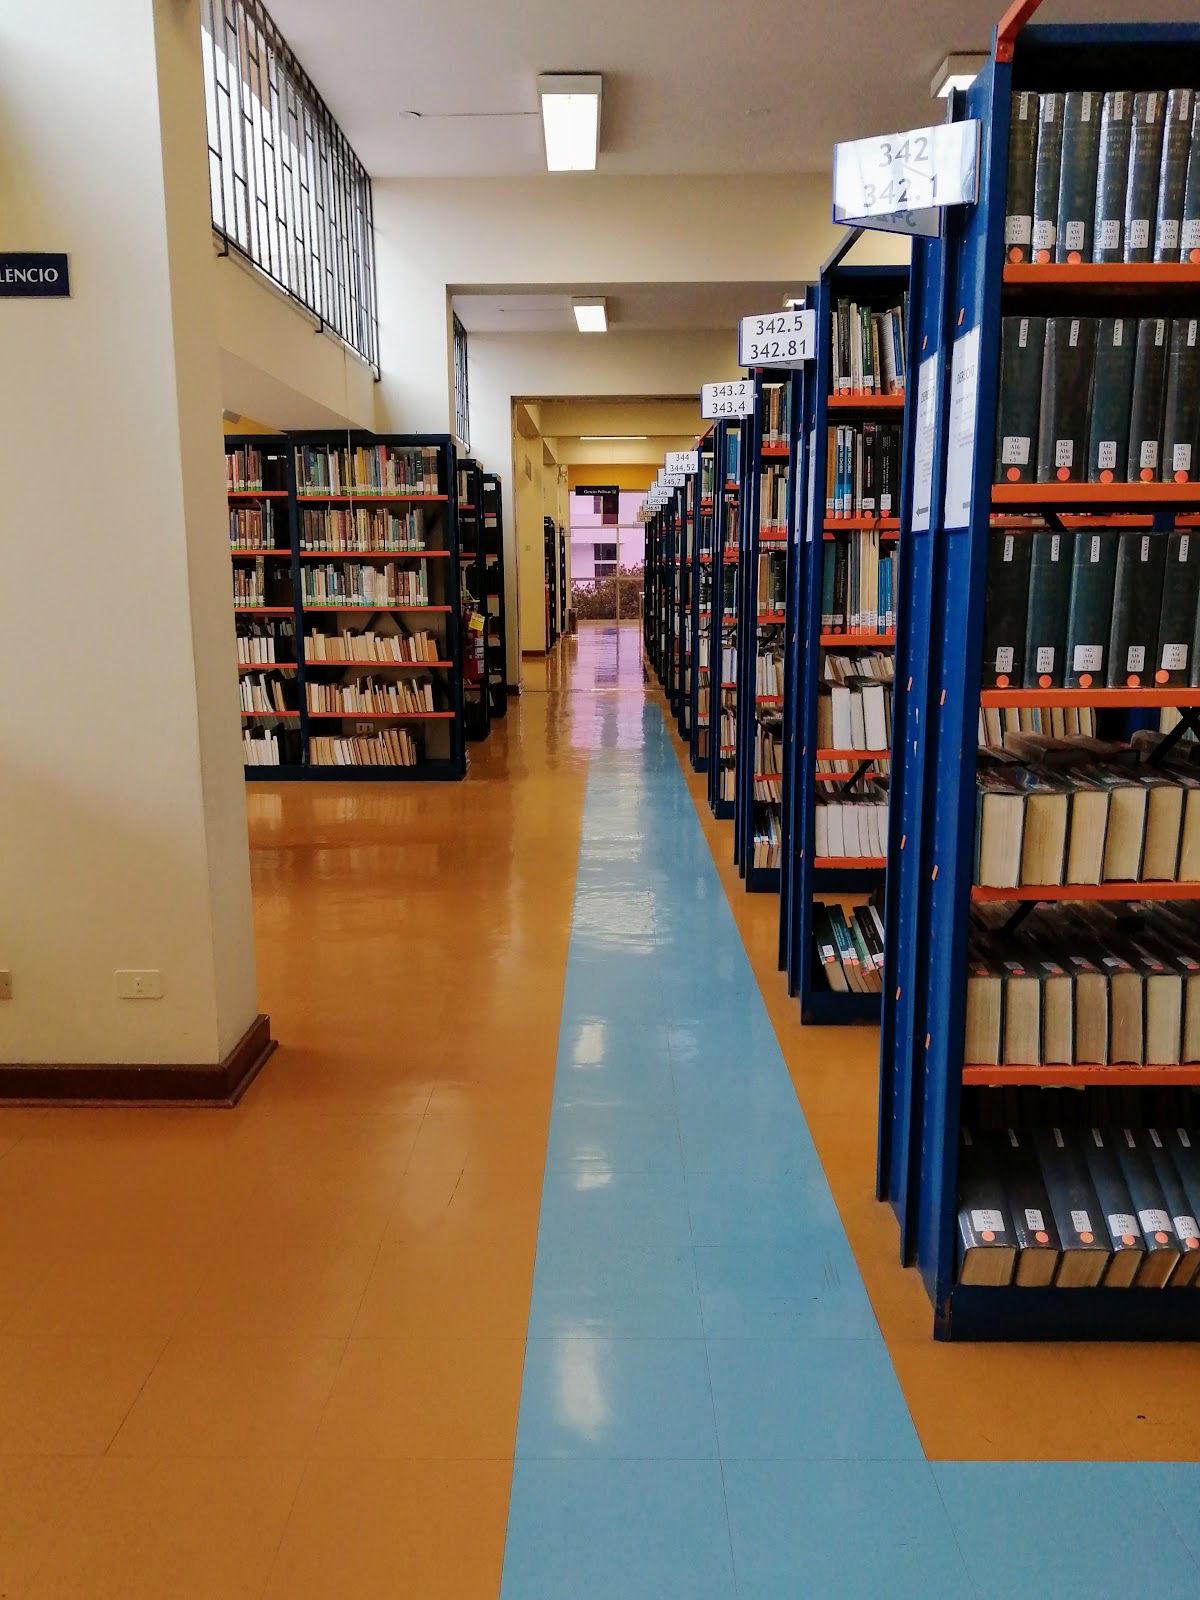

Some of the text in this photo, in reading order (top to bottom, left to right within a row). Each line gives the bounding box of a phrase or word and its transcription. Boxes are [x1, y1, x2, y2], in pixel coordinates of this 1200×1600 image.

[878, 136, 929, 167] 342
[863, 173, 937, 208] 342.1
[0, 268, 58, 283] LENCIO
[756, 316, 803, 336] 342.5
[750, 339, 806, 359] 342.81
[712, 384, 745, 397] 343.2
[712, 401, 745, 414] 343.4
[670, 464, 695, 472] 344.52
